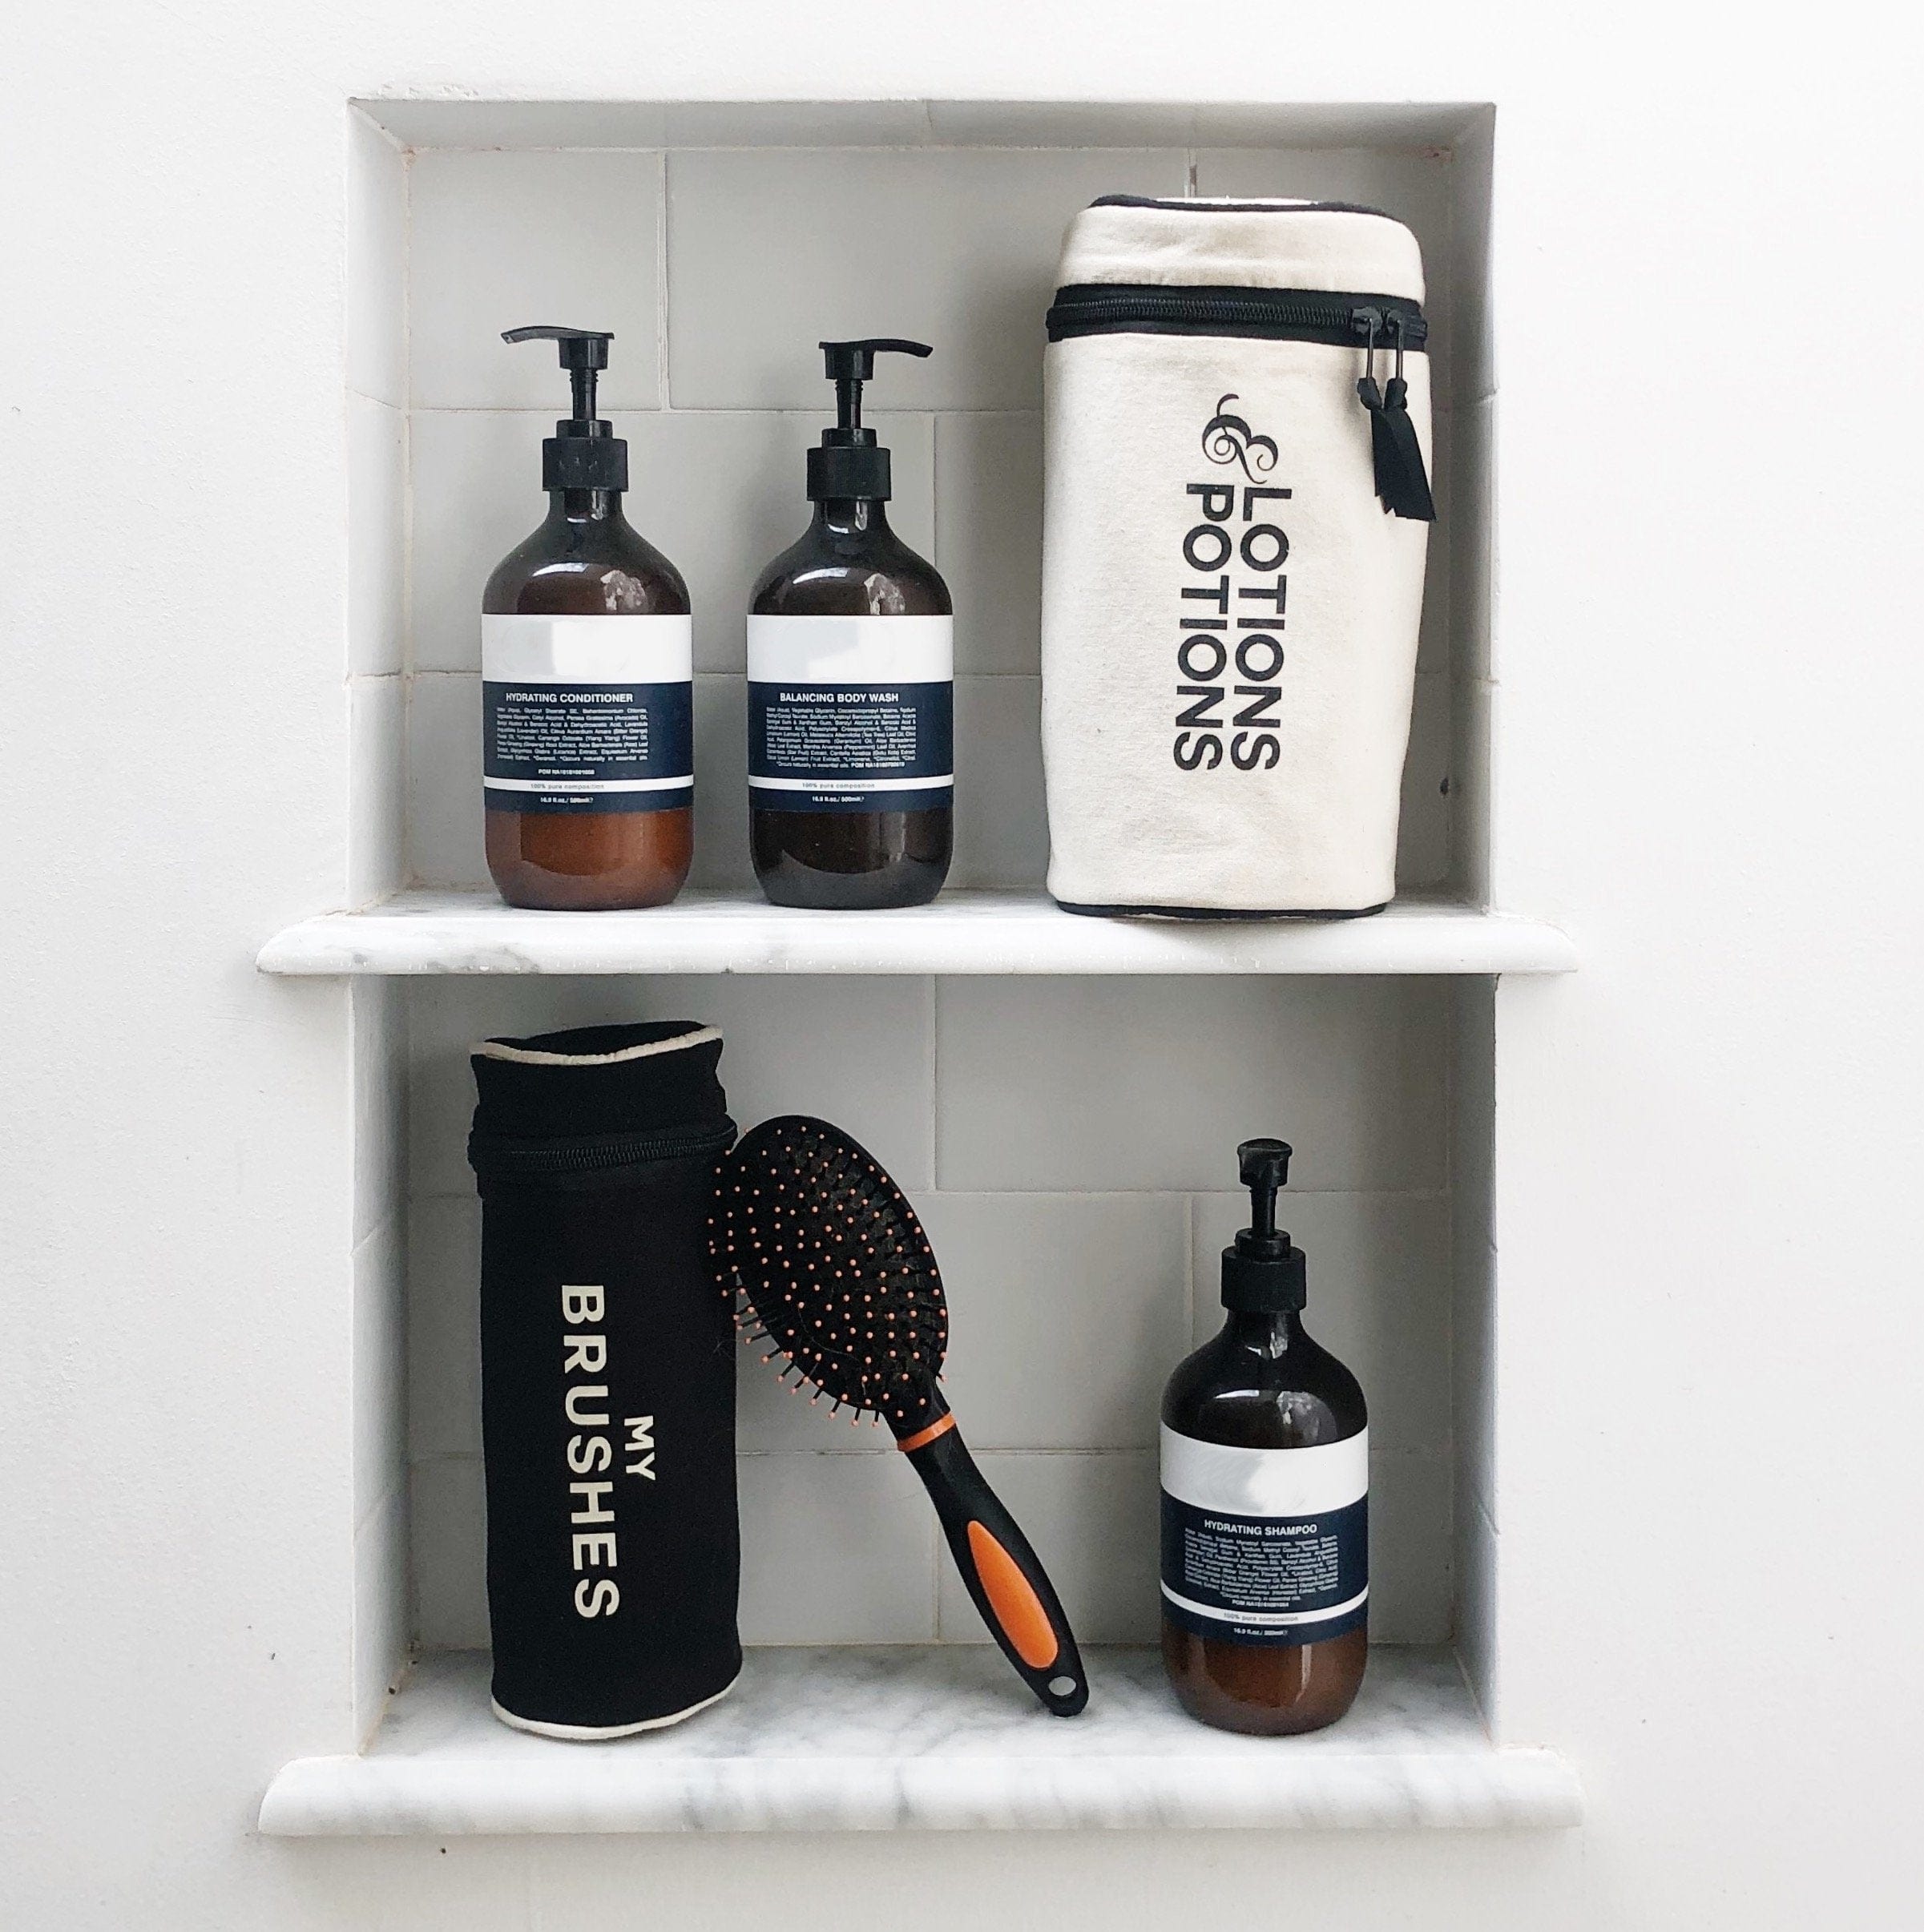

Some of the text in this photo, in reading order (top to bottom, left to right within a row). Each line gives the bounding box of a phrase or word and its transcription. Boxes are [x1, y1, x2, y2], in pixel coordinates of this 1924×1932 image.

[1173, 483, 1235, 771] POTIONS
[1230, 486, 1293, 771] LOTIONS
[506, 692, 634, 703] HYDRATING CONDITIONER
[780, 692, 899, 703] BALANCING BODY WASH
[562, 1285, 620, 1618] BRUSHES
[623, 1415, 656, 1481] MY
[1204, 1519, 1318, 1535] HYDRATING SHAMPOO
